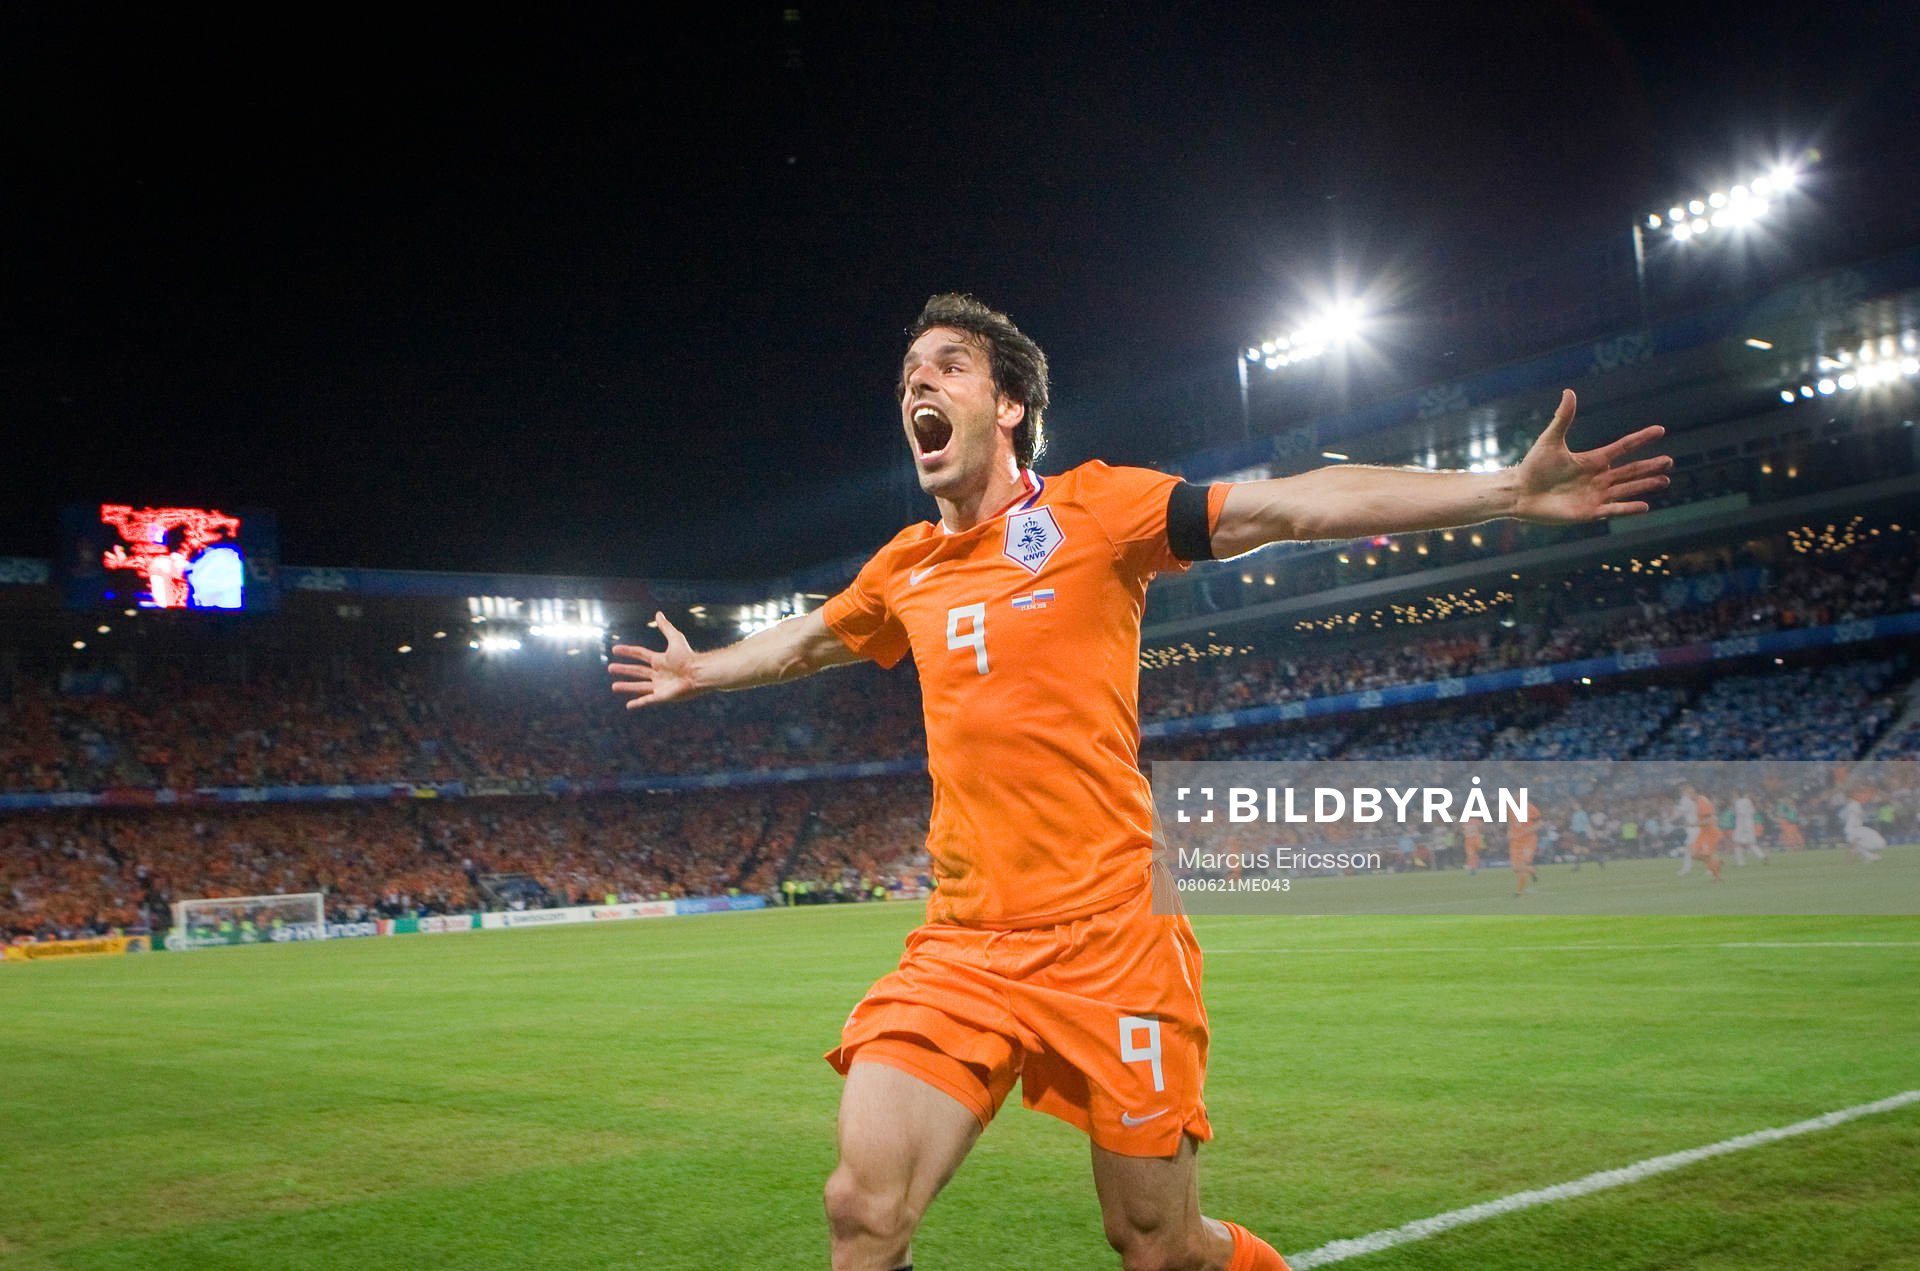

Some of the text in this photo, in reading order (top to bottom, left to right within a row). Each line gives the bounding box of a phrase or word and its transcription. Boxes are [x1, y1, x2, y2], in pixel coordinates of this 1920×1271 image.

[1023, 551, 1046, 562] KNVB
[947, 602, 989, 674] 9
[1119, 1016, 1165, 1092] 9
